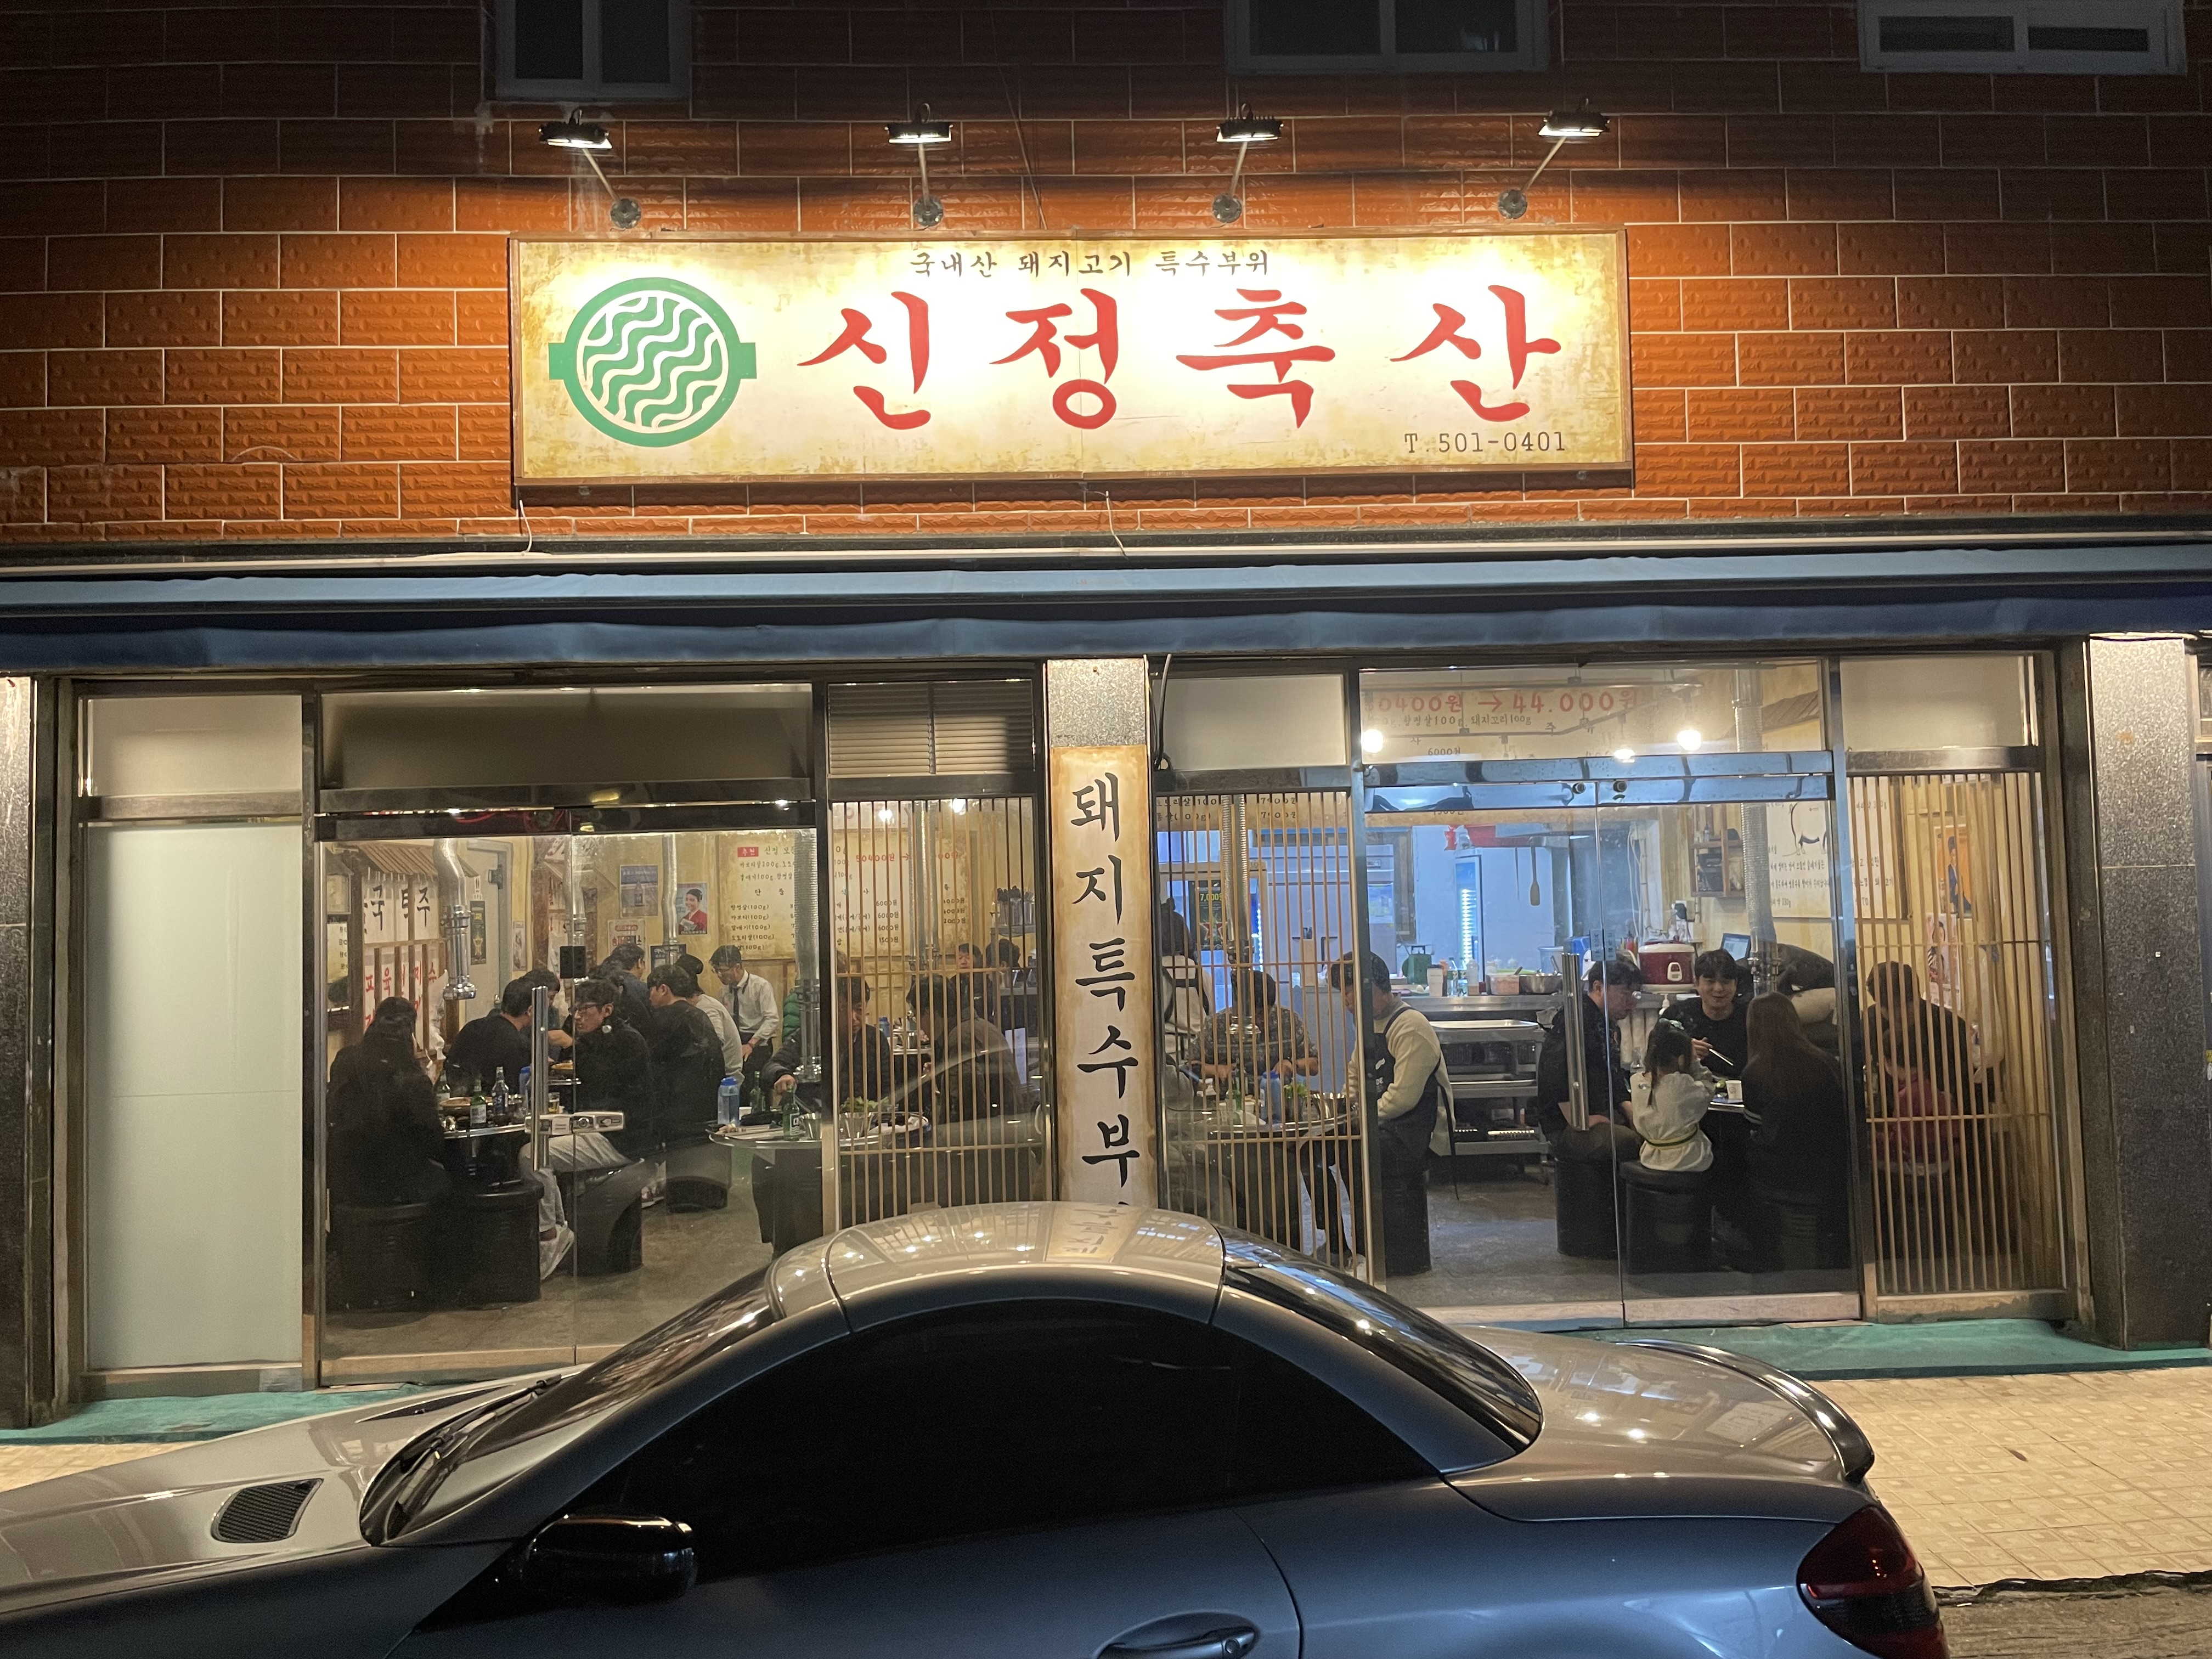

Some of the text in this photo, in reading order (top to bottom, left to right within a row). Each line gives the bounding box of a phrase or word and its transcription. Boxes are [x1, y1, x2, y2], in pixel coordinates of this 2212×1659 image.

[910, 250, 1268, 278] 국내산 돼지고기 특수부위
[797, 284, 1562, 430] 신정축산
[1070, 771, 1141, 1206] 돼지특수부
